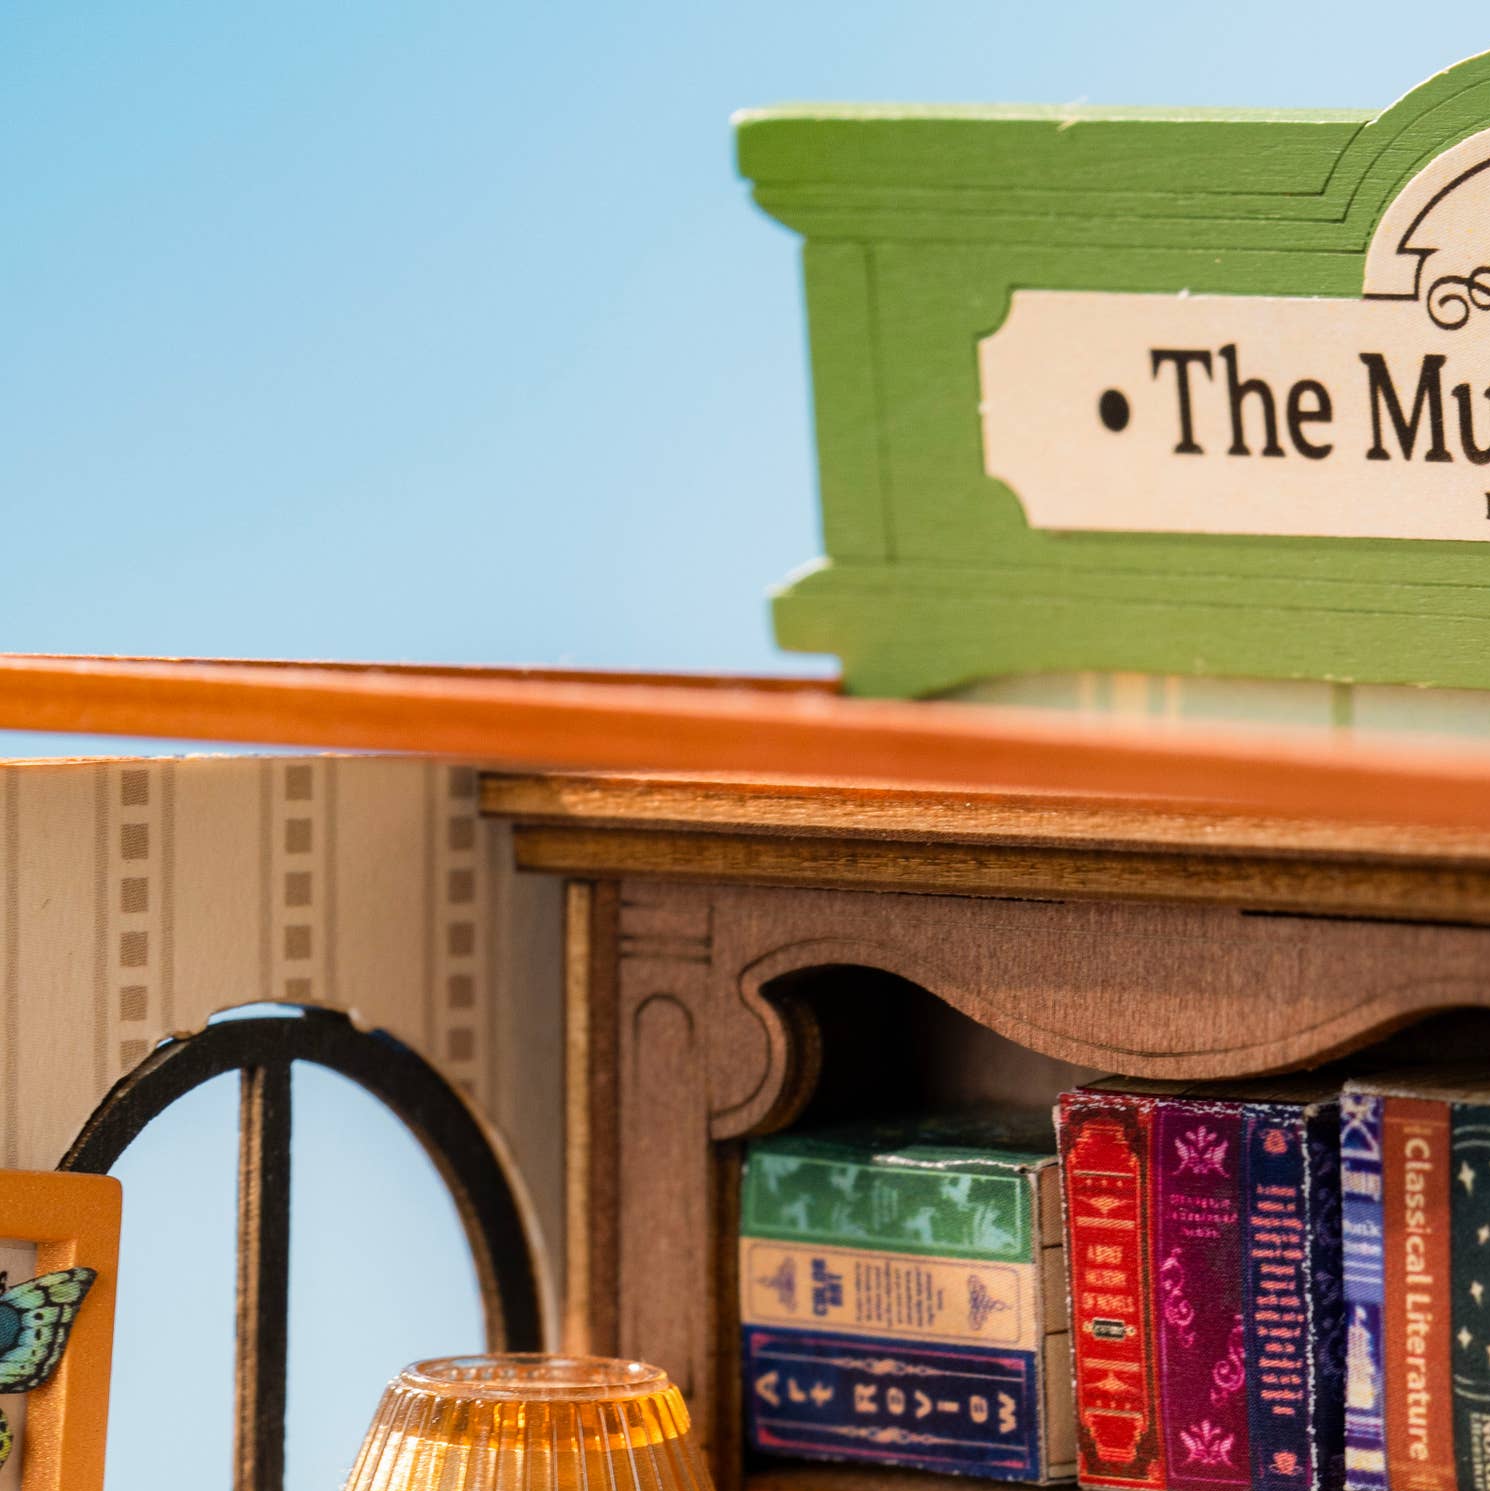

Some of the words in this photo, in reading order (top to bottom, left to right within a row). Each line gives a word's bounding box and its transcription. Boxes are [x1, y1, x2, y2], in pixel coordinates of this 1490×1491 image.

[1149, 343, 1334, 461] The
[1404, 1138, 1434, 1286] Classical
[755, 1371, 835, 1408] Art
[854, 1383, 1017, 1434] Review
[1404, 1291, 1434, 1461] Literature
